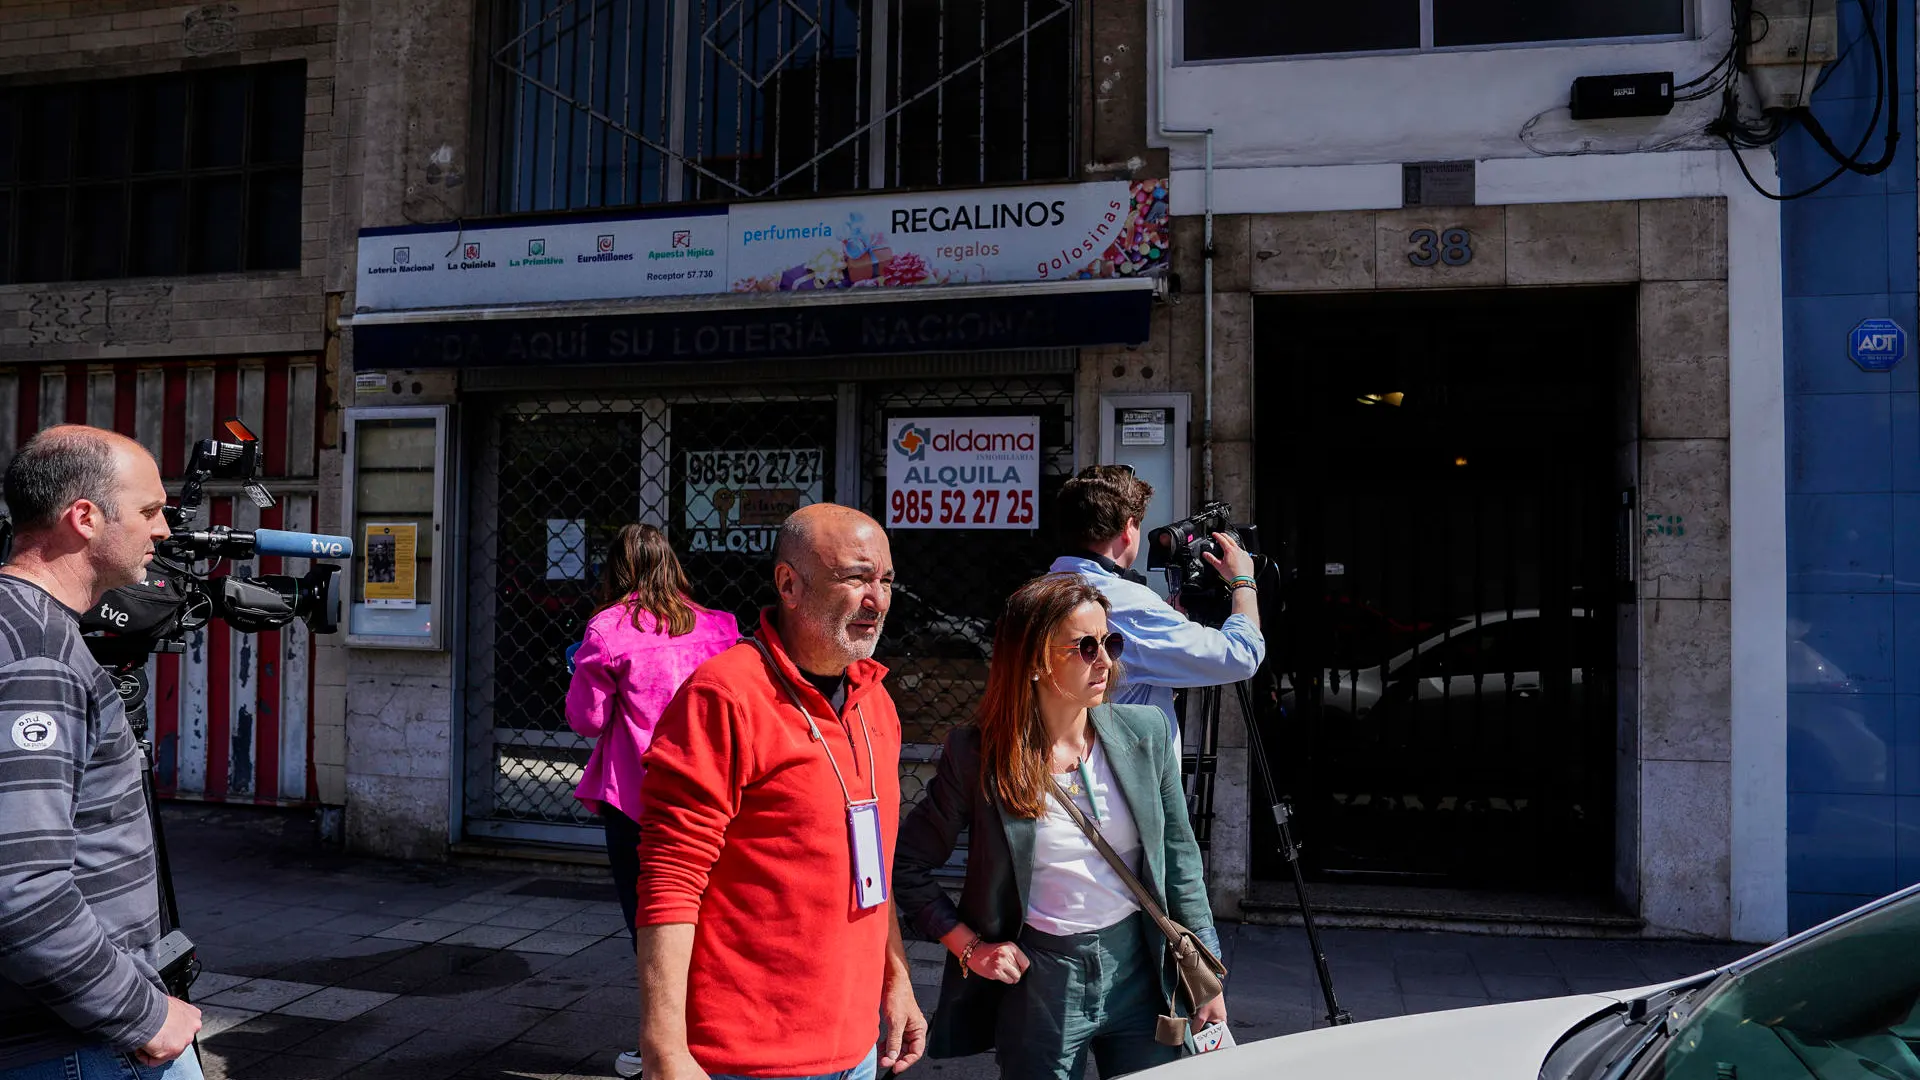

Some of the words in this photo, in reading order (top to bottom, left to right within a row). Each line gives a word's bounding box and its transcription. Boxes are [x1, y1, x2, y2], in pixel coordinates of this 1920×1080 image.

[890, 201, 1065, 234] REGALINOS
[743, 222, 832, 244] perfumería
[1038, 201, 1121, 279] golosinas
[577, 252, 633, 263] EuroMillones
[648, 250, 684, 260] Apuesta
[936, 242, 999, 262] regalos
[1408, 229, 1471, 266] 38
[399, 264, 434, 272] Nacional
[461, 260, 495, 270] Quiniela
[523, 256, 563, 266] Primitiva
[647, 272, 685, 281] Receptor
[687, 270, 713, 279] 57.730
[506, 323, 589, 360] AQUÍ
[607, 328, 654, 357] SU
[672, 315, 830, 357] LOTERÍA
[1858, 334, 1897, 351] ADT
[933, 429, 1034, 452] aldama
[689, 454, 728, 485] 985
[733, 454, 759, 484] 52
[765, 453, 789, 483] 27
[795, 452, 820, 483] 27
[904, 466, 1021, 487] ALQUILA
[892, 490, 933, 524] 985
[940, 490, 966, 524] 52
[972, 490, 999, 524] 27
[1006, 490, 1034, 524] 25
[311, 538, 343, 558] tve
[101, 603, 129, 627] tve
[1197, 1025, 1221, 1041] ATLAS
